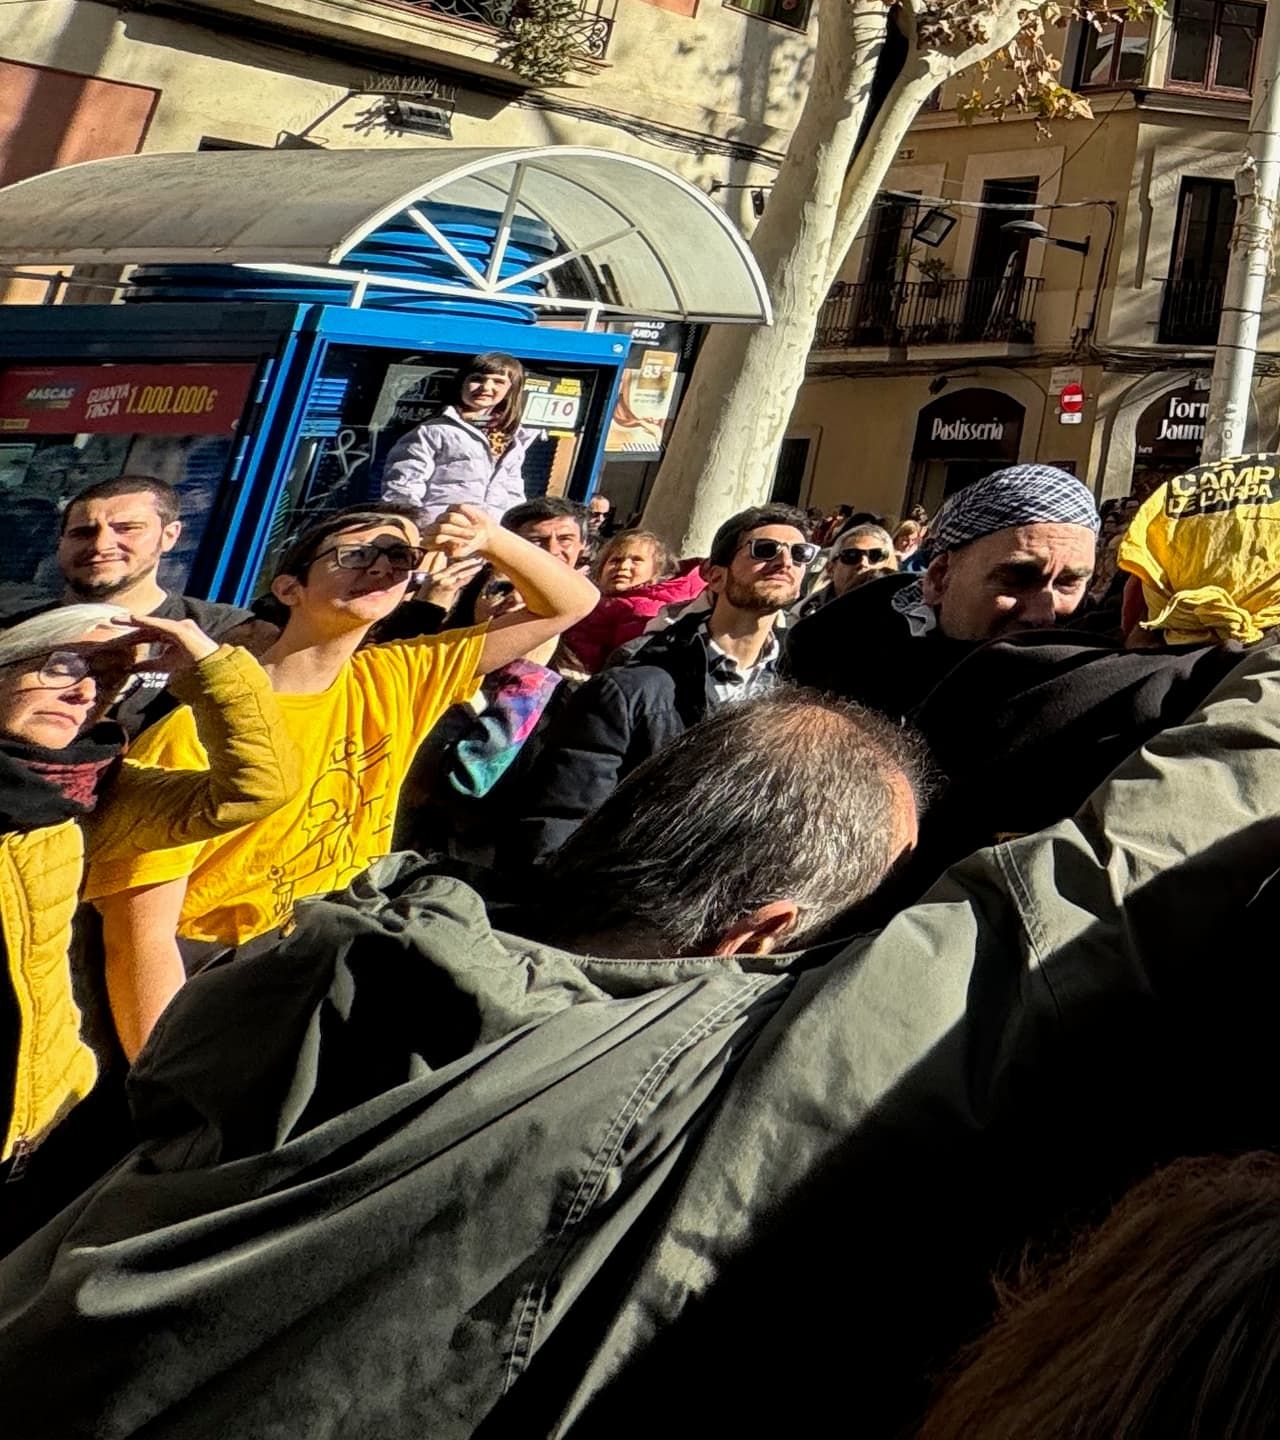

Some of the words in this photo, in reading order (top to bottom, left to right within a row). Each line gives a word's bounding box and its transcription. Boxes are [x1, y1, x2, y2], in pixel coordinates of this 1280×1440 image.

[931, 417, 1004, 440] Pastisseria
[1156, 419, 1205, 440] Jaum
[1171, 465, 1275, 497] CAMP
